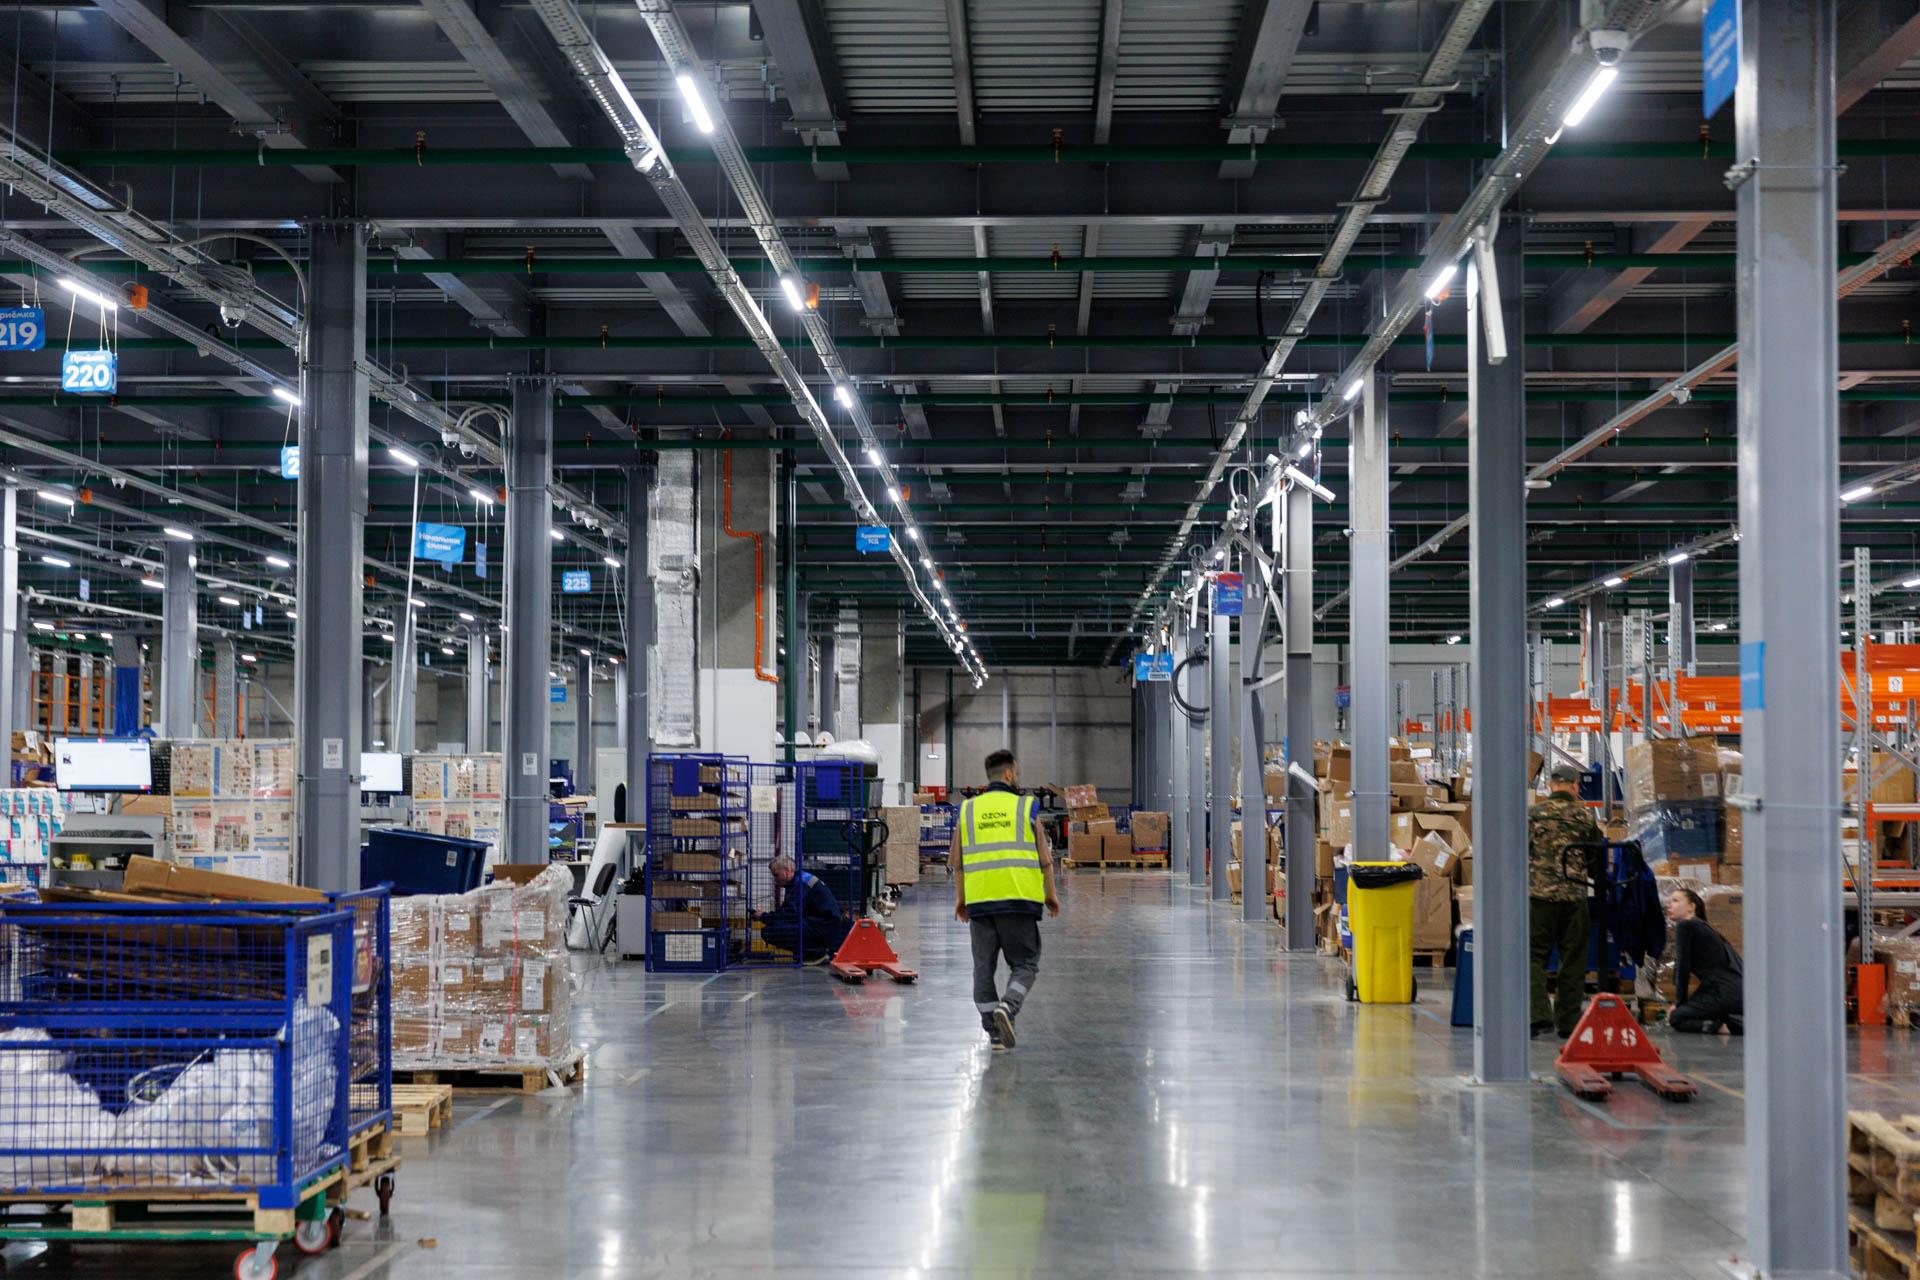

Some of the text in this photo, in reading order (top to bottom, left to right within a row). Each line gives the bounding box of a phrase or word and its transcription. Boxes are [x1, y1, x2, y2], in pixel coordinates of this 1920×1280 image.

[65, 364, 110, 388] 220
[564, 578, 589, 591] 225
[981, 812, 1007, 820] OZON
